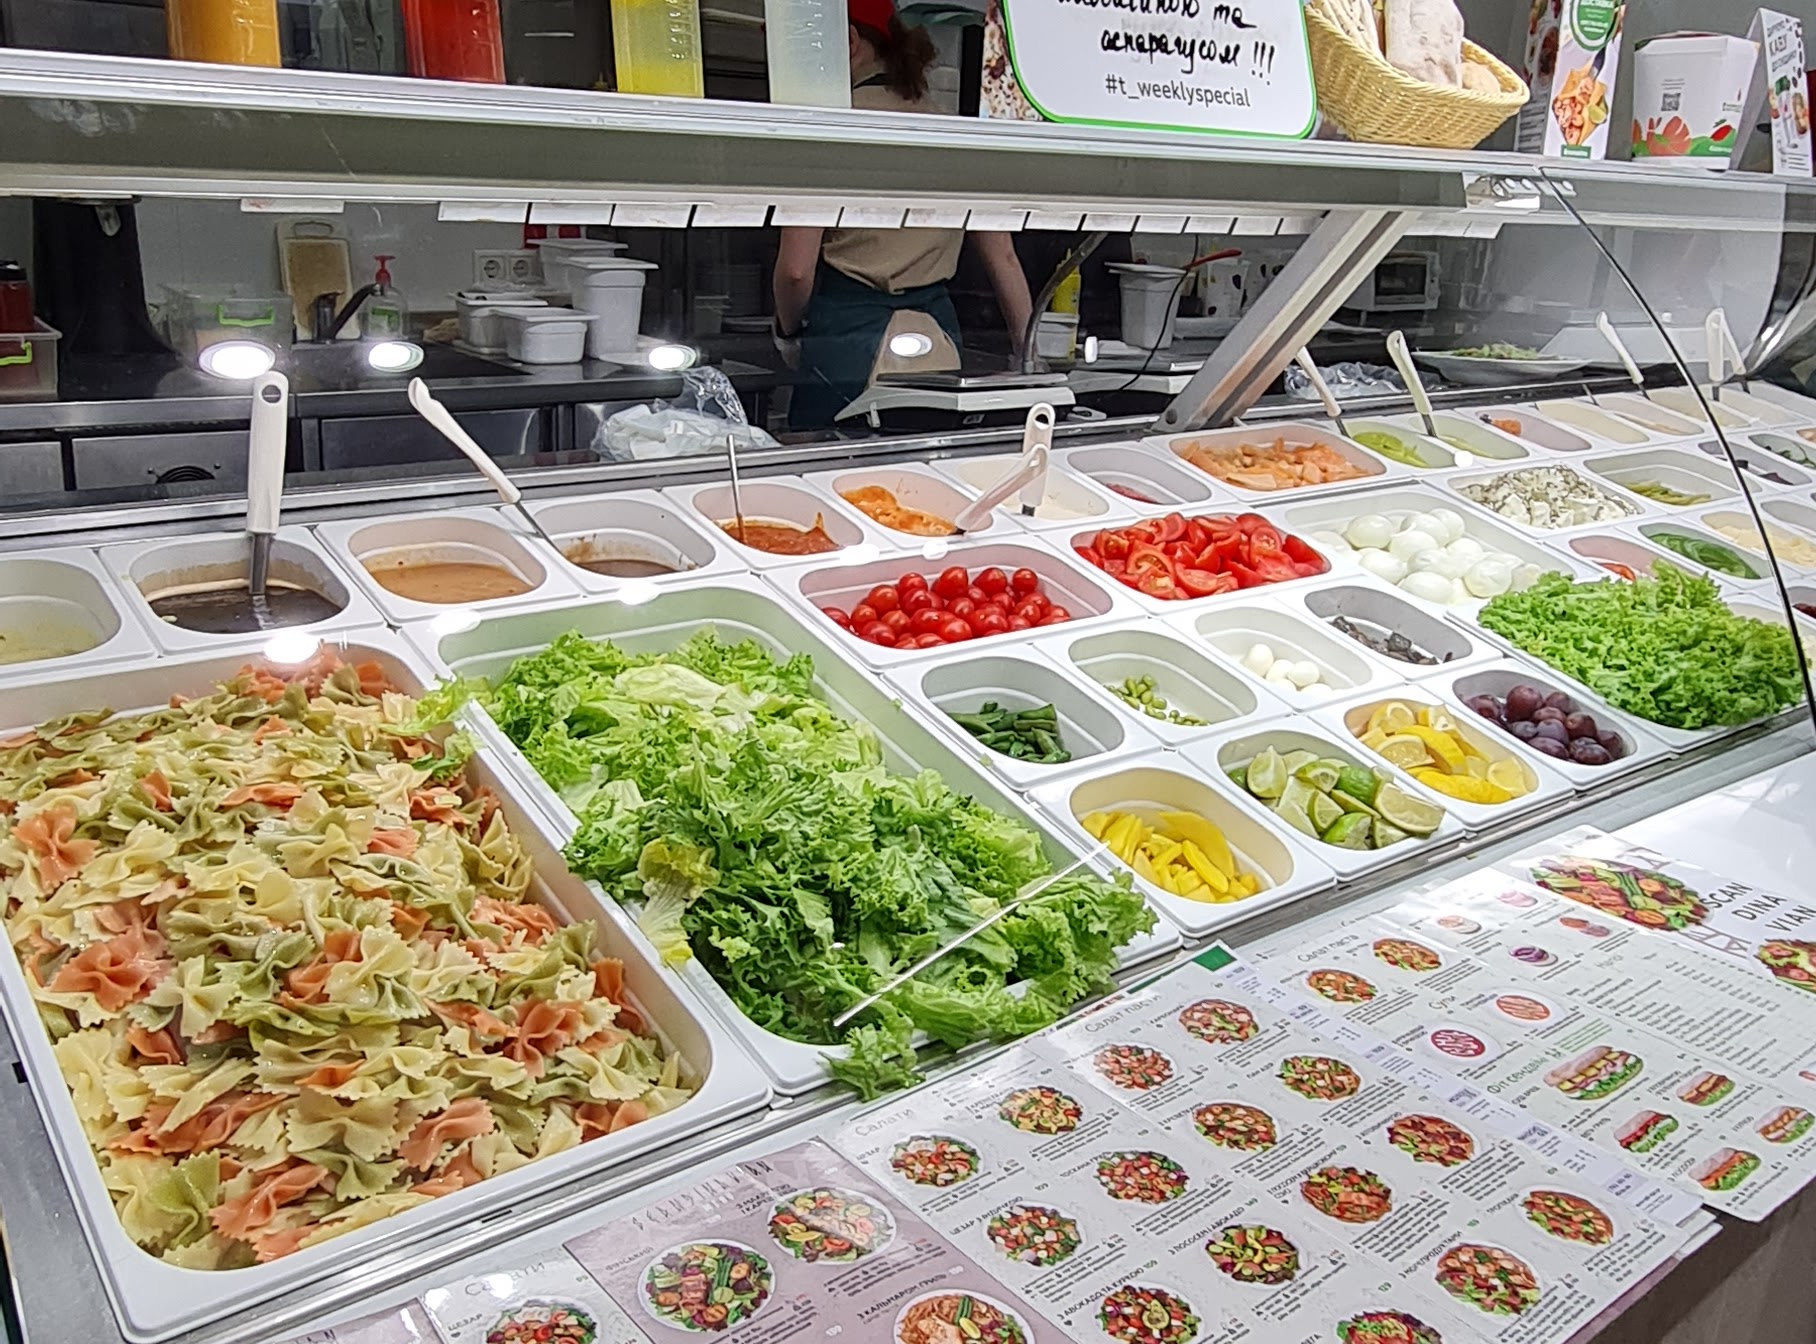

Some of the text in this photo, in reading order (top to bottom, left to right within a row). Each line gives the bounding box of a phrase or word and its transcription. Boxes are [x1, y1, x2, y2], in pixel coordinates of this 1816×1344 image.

[1213, 4, 1258, 29] та
[1105, 74, 1251, 108] #t_weeklyspecial
[1699, 882, 1752, 908] SCAN
[1732, 895, 1787, 921] DINA
[1765, 905, 1816, 933] VIAN
[855, 1108, 914, 1136] Салати
